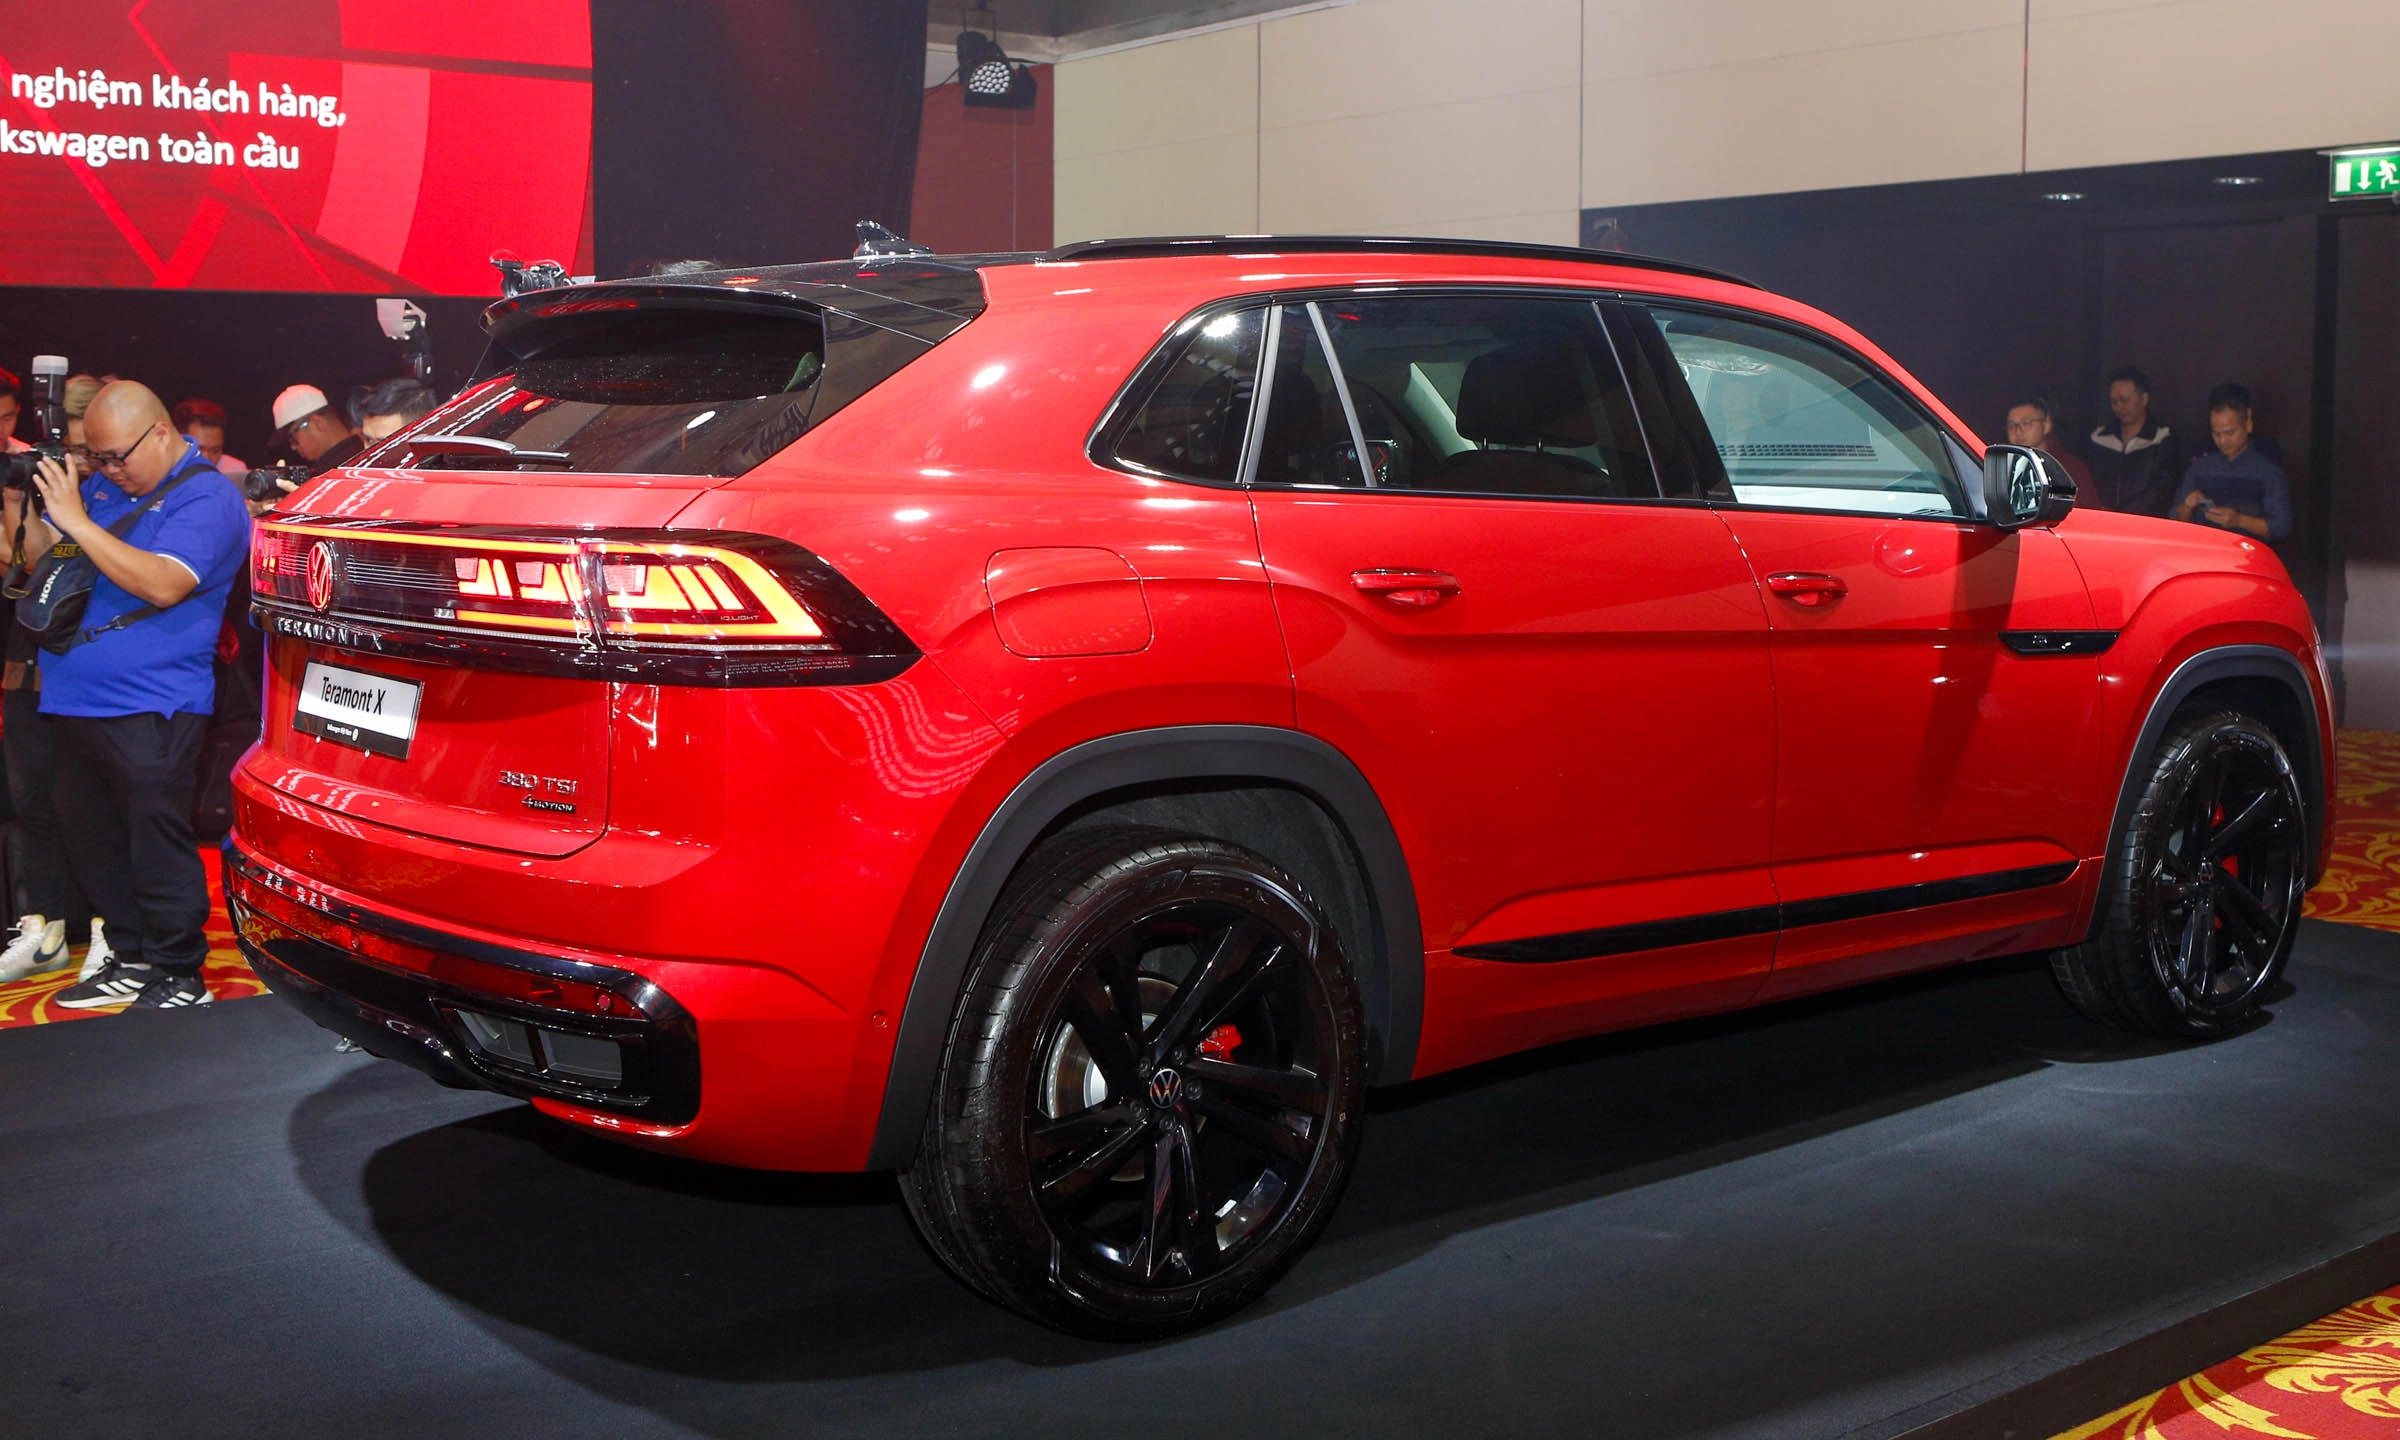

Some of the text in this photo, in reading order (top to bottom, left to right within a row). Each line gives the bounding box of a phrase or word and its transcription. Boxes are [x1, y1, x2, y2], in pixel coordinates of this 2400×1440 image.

[11, 66, 347, 128] nghiệm khách hàng,
[157, 131, 235, 166] toàn
[243, 131, 300, 170] cầu
[38, 564, 65, 606] HON
[277, 617, 383, 652] TERAMONT X
[321, 676, 387, 716] Teramont X
[498, 769, 579, 795] 380 TSI
[521, 794, 574, 813] 4MOTION
